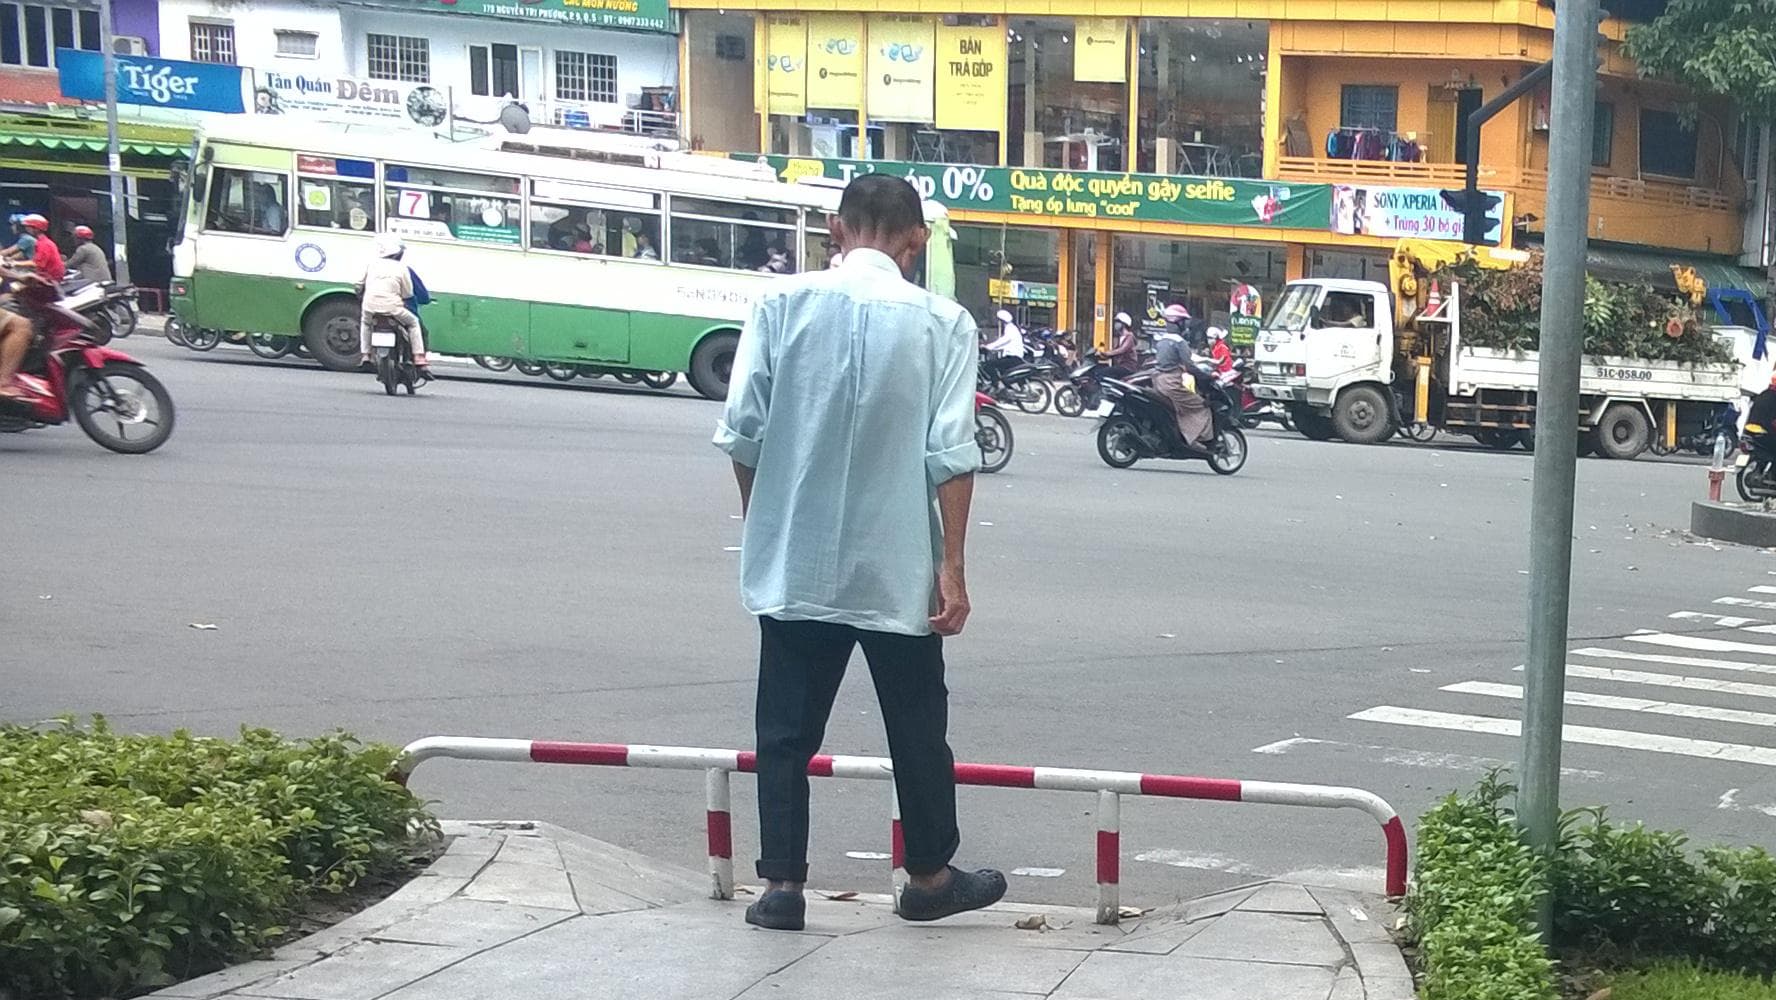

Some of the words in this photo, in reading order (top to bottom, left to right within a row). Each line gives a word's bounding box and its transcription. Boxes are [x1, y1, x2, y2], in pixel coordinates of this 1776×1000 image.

[123, 65, 199, 103] Tiger
[296, 75, 331, 95] Quán
[337, 79, 401, 105] Đêm
[942, 166, 994, 201] 0%
[1010, 170, 1048, 191] Quà
[1052, 172, 1084, 197] độc
[1088, 172, 1143, 198] quyền
[1148, 179, 1181, 202] gậy
[1184, 180, 1235, 201] selfie
[406, 193, 422, 215] 7
[1066, 197, 1097, 217] lưng
[1374, 192, 1400, 209] SONY
[1402, 193, 1437, 211] XPERIA
[1422, 216, 1435, 232] 30
